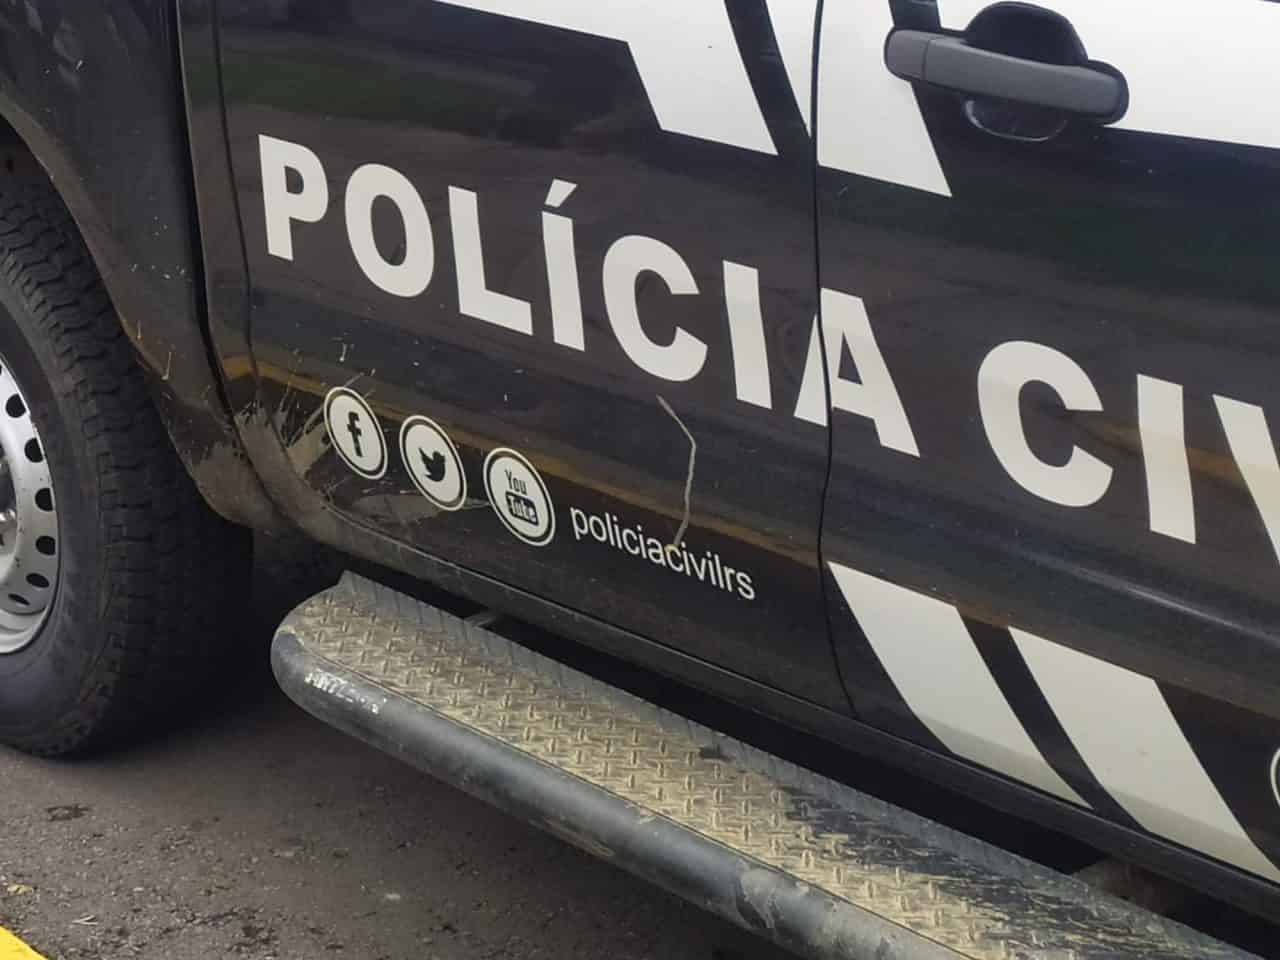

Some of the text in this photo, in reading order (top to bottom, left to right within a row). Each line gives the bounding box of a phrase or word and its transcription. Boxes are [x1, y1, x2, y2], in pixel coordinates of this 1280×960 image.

[258, 134, 920, 458] POLÍCIA
[504, 469, 528, 495] You
[505, 492, 539, 526] Tube
[570, 507, 756, 600] policiacivilrs
